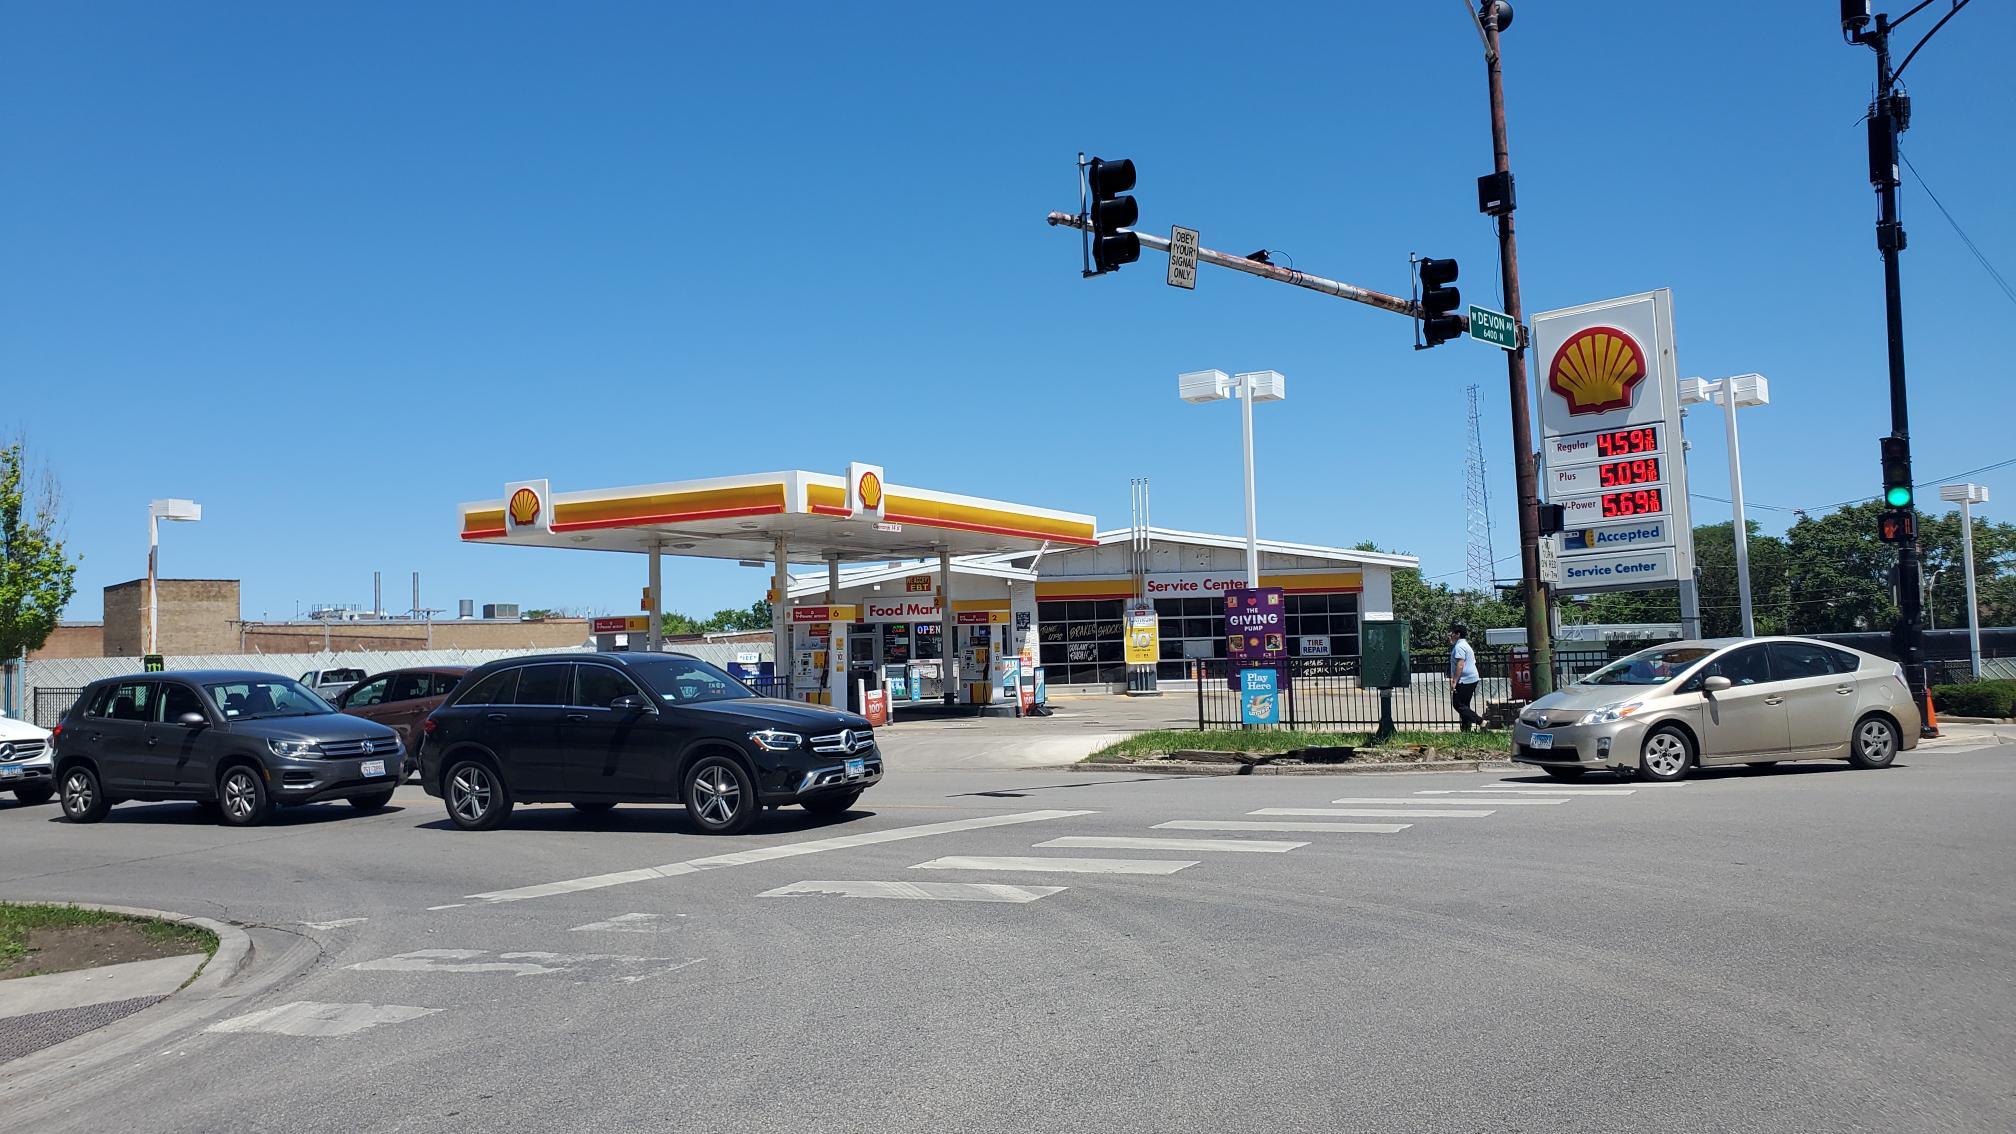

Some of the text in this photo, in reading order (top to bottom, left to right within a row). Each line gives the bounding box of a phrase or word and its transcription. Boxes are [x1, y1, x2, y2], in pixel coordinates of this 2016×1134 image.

[1176, 232, 1194, 245] OBEY
[1175, 244, 1194, 257] YOUR
[1172, 256, 1196, 269] SIGNAL
[1478, 312, 1504, 331] DEVON
[1484, 329, 1497, 340] 6400
[1557, 440, 1588, 453] Regular
[1560, 472, 1576, 481] Plus
[1562, 501, 1596, 511] V-Power
[1597, 526, 1659, 542] Accepted
[1567, 562, 1656, 578] Service Center
[1147, 579, 1248, 592] Service Center
[869, 603, 940, 616] Food Mart
[1230, 613, 1278, 625] GIVING
[917, 625, 940, 635] OPEN
[1247, 673, 1268, 682] Play
